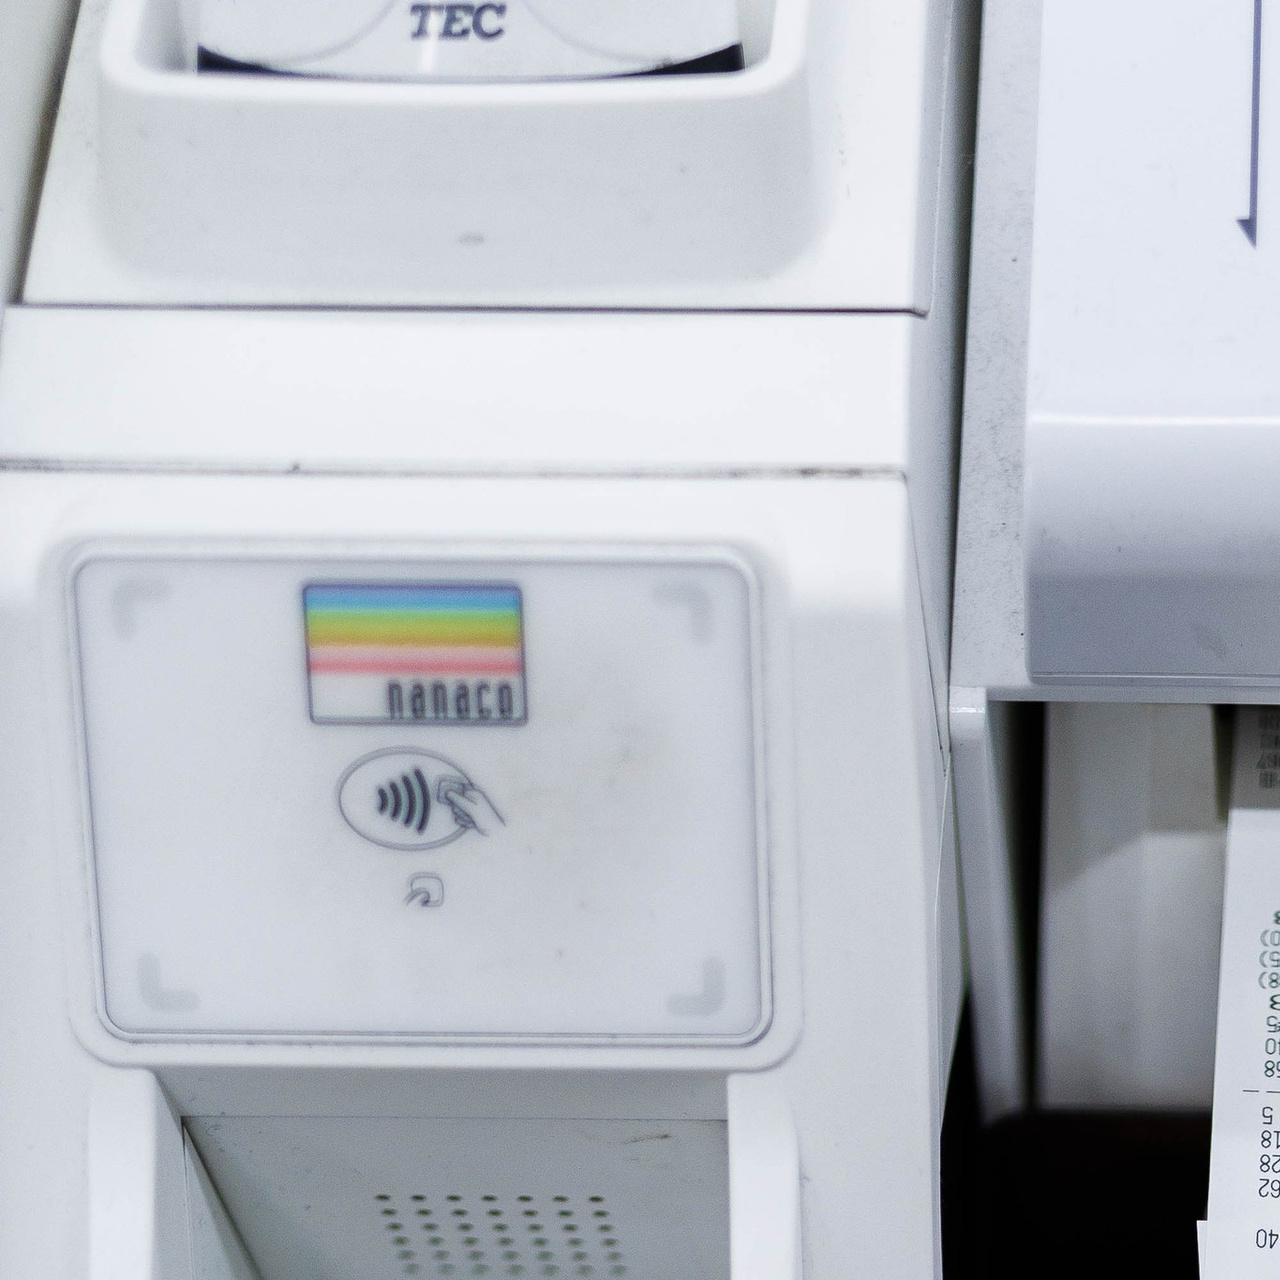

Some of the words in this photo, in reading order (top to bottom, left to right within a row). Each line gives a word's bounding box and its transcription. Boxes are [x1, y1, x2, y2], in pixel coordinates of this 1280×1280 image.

[410, 2, 506, 39] TEC
[388, 679, 514, 720] nanaco
[1261, 1106, 1273, 1125] 5
